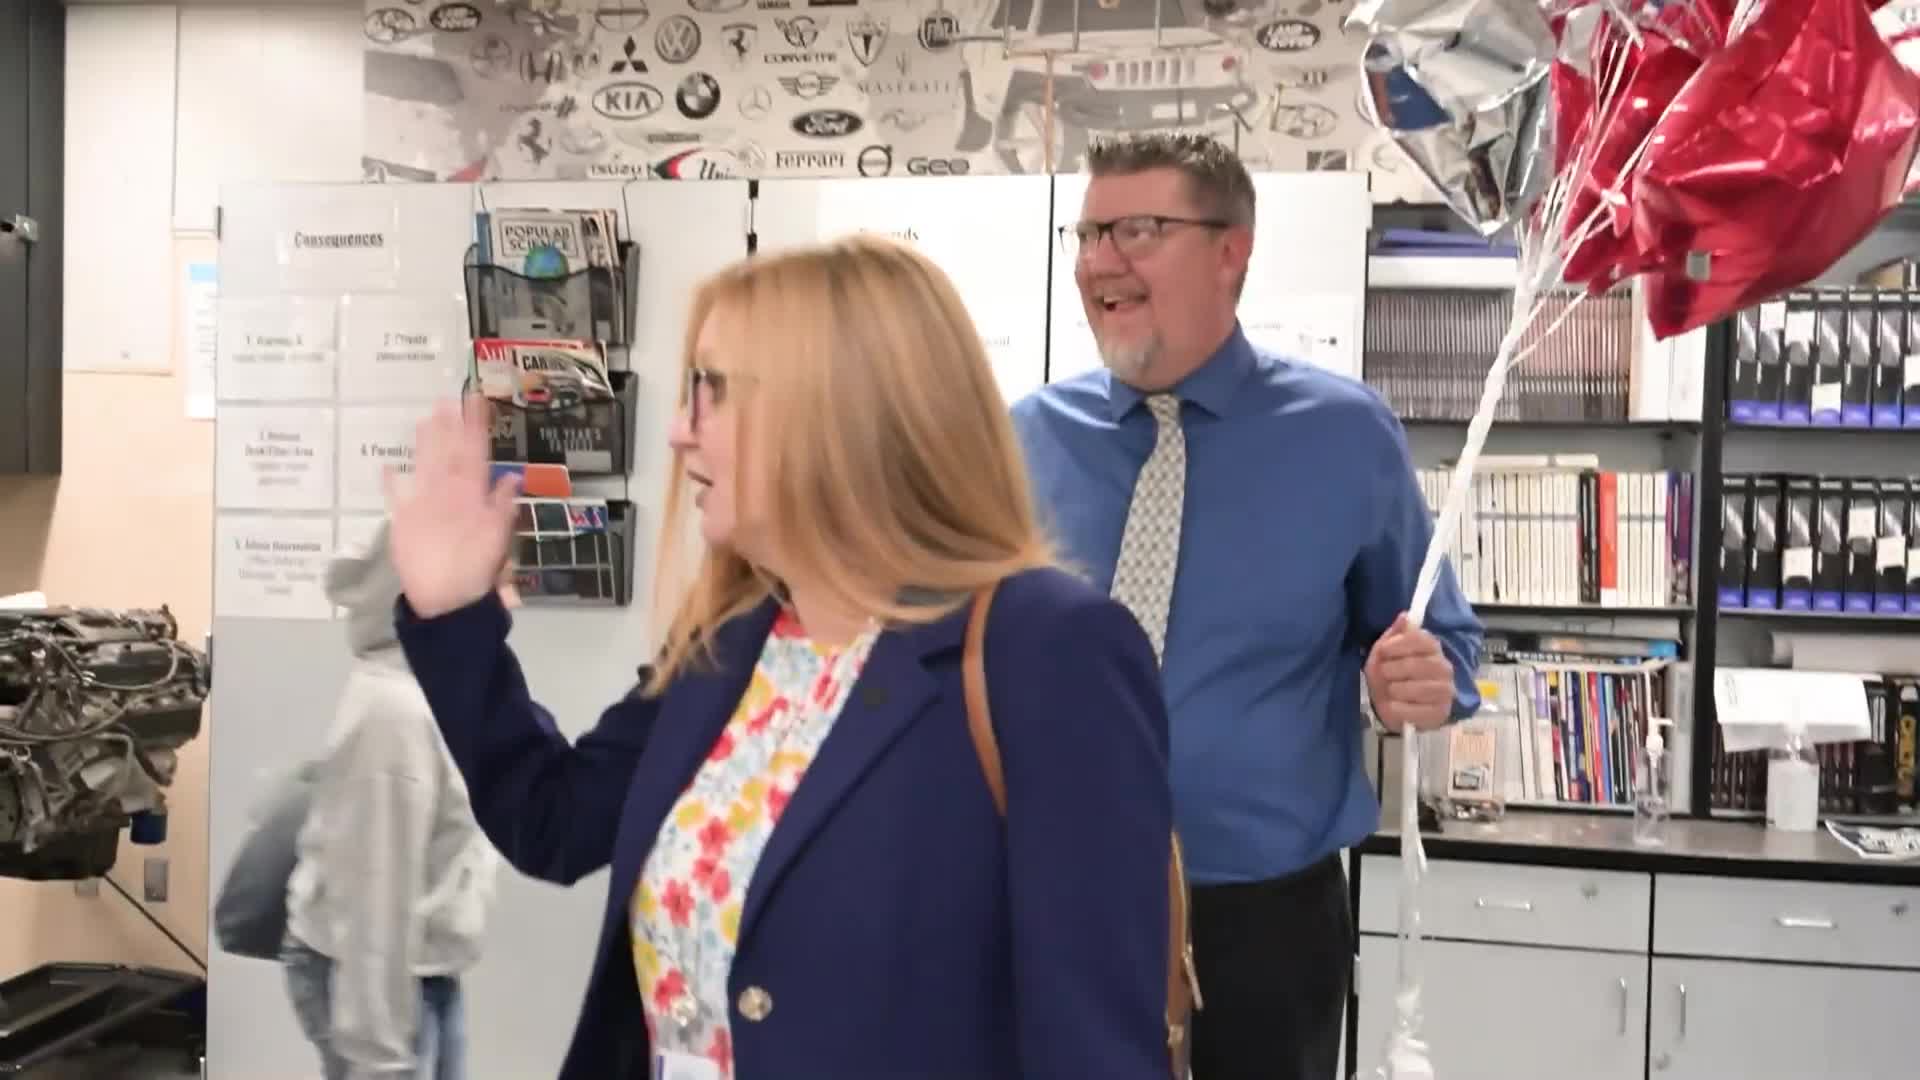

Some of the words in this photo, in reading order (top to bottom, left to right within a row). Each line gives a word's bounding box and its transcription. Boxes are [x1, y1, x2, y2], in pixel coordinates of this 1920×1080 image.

[605, 91, 650, 111] KIA
[775, 151, 845, 169] Ferrari
[294, 231, 384, 249] Consequences
[505, 226, 570, 241] POPULAR
